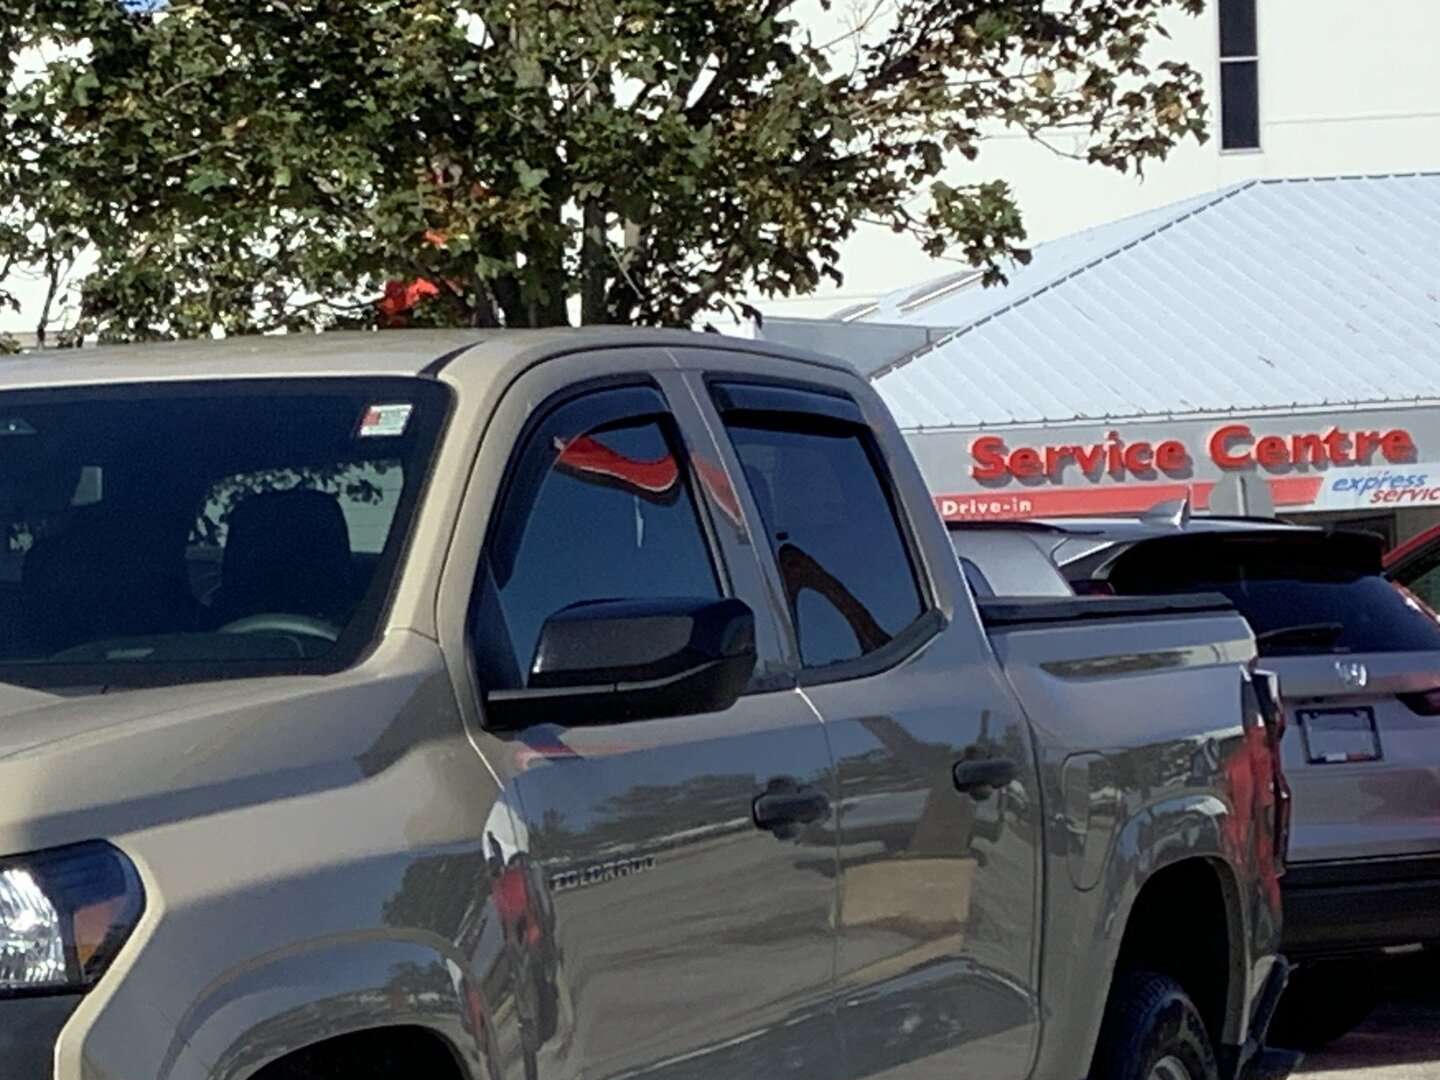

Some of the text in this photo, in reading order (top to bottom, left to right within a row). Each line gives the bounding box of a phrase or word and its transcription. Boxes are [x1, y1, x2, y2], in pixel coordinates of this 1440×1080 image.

[971, 423, 1415, 481] Service Centre
[1332, 473, 1428, 496] express
[941, 497, 1032, 516] Drive-in
